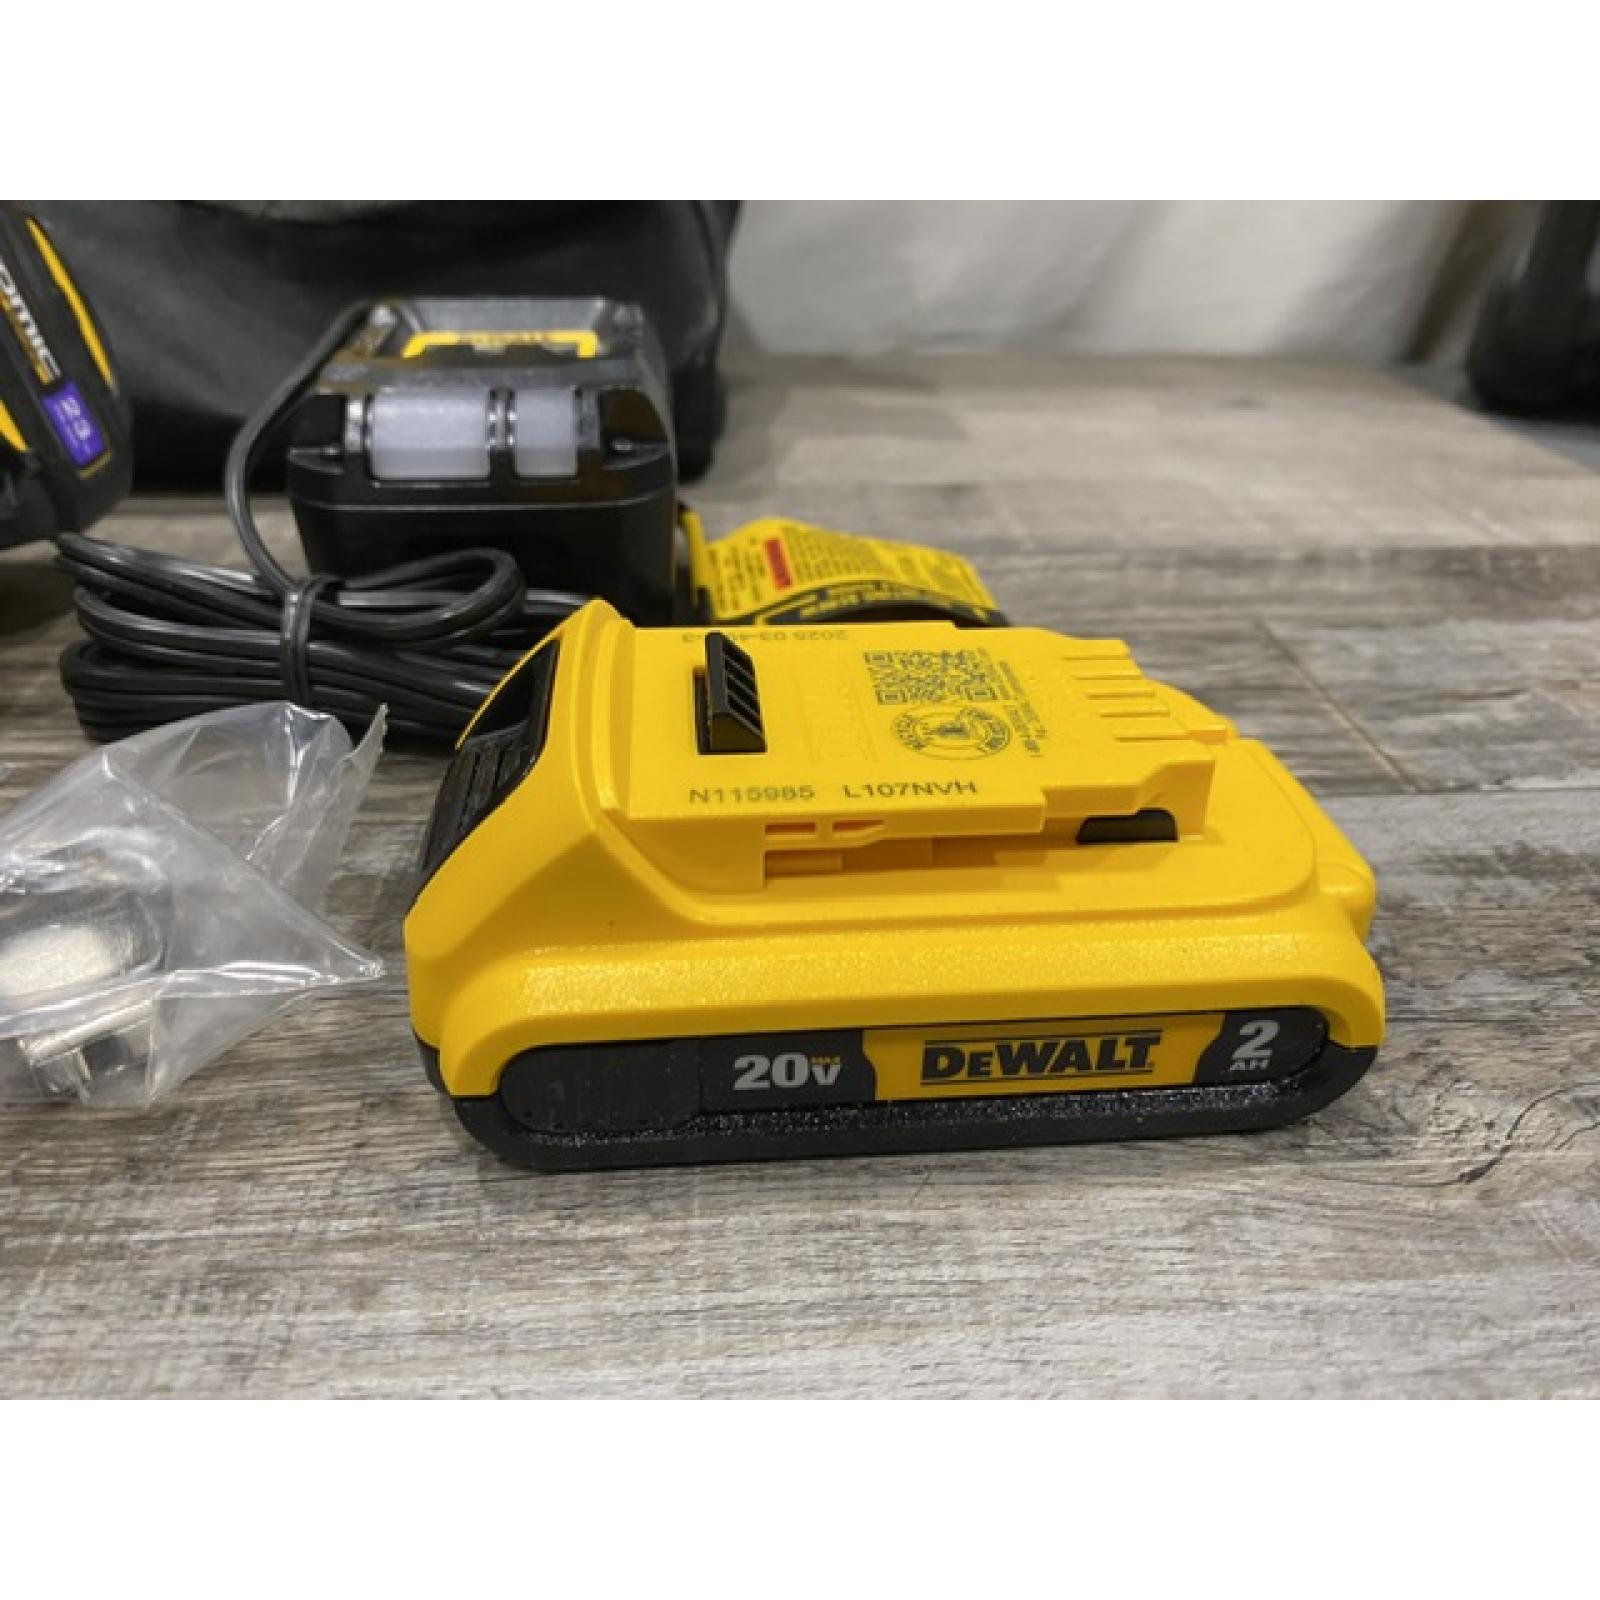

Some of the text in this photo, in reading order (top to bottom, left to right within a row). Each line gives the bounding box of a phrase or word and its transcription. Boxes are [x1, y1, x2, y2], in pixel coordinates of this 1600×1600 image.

[921, 1037, 1160, 1079] DEWALT
[1232, 1019, 1280, 1059] 2
[1230, 1058, 1270, 1072] AH
